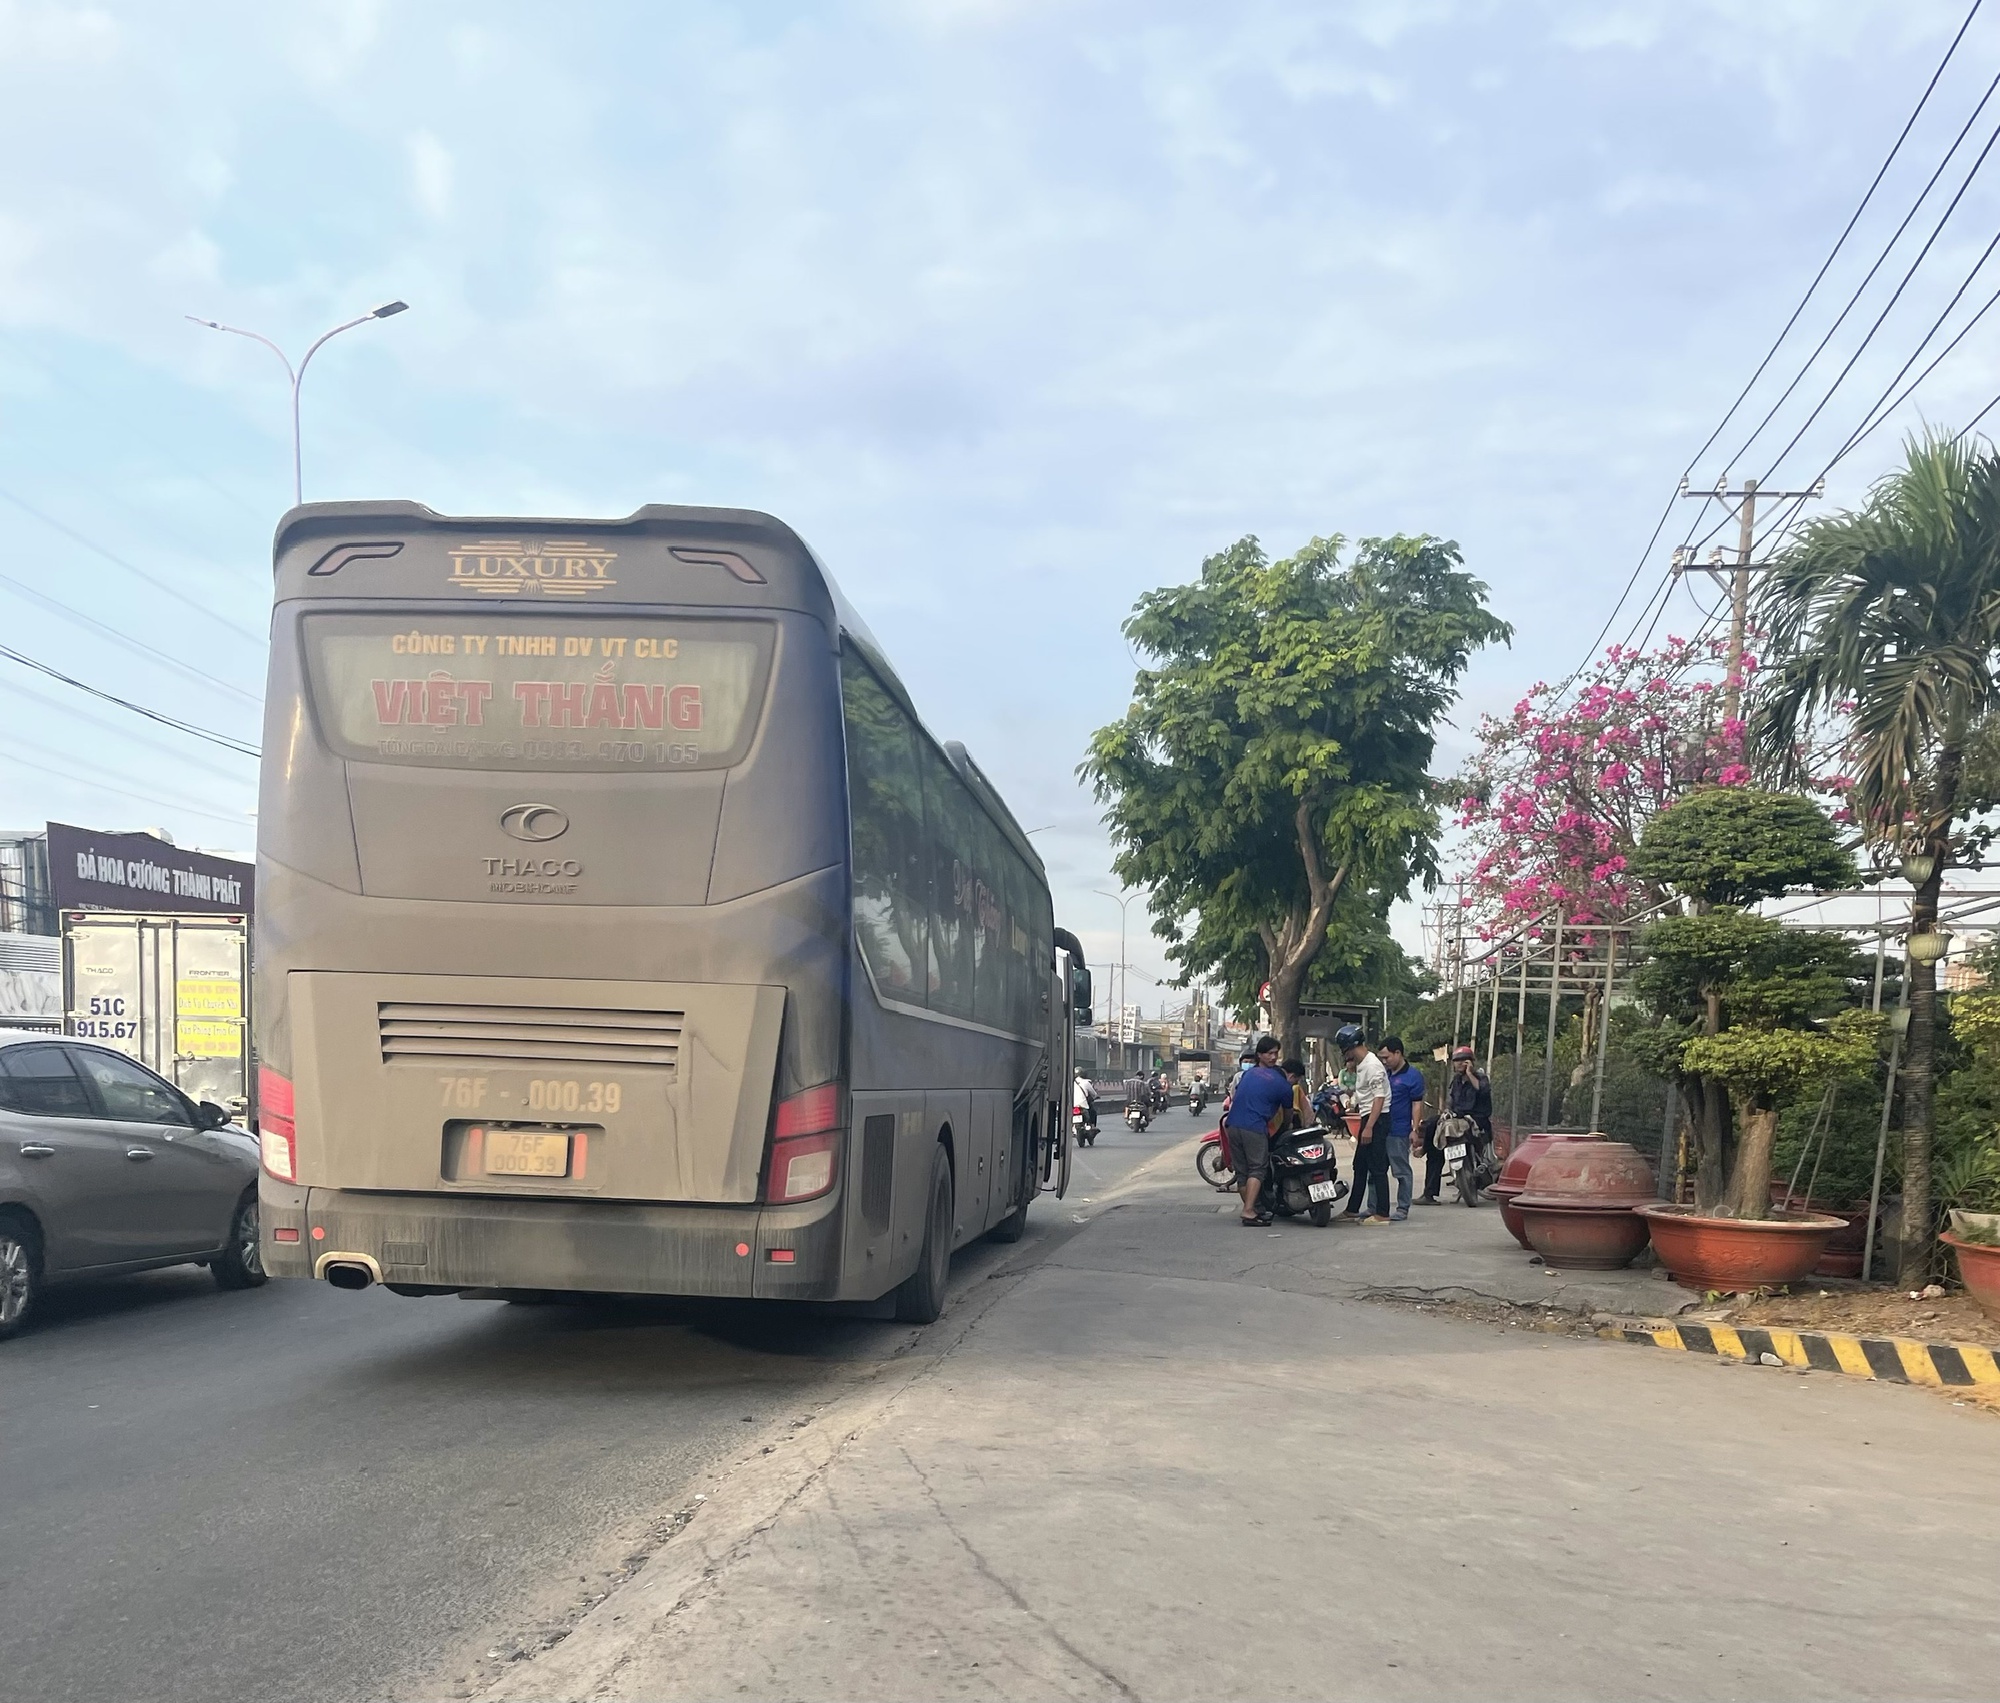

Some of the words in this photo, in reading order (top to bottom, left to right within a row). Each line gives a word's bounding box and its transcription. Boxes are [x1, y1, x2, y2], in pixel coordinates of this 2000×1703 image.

[453, 557, 614, 578] LUXURY
[392, 630, 455, 654] CÔNG
[462, 635, 488, 655] TY
[496, 636, 556, 656] TNHH
[564, 637, 593, 657] DV
[601, 638, 627, 658] VT
[635, 638, 678, 659] CLC
[371, 669, 492, 733] VIỆT
[513, 660, 702, 731] THẮNG
[654, 742, 698, 764] 165
[77, 848, 98, 880] ĐÁ
[98, 856, 126, 886] HOA
[127, 859, 170, 894] CƯƠNG
[173, 866, 211, 901] THÀNH
[212, 874, 241, 905] PHÁT
[482, 857, 583, 877] THACO
[189, 969, 230, 977] FRONTIER
[90, 998, 125, 1016] 51C
[77, 1021, 137, 1039] 915.67
[439, 1077, 488, 1109] 76F
[530, 1079, 622, 1113] 000.39
[511, 1135, 544, 1153] 76F
[494, 1154, 556, 1172] 000.39
